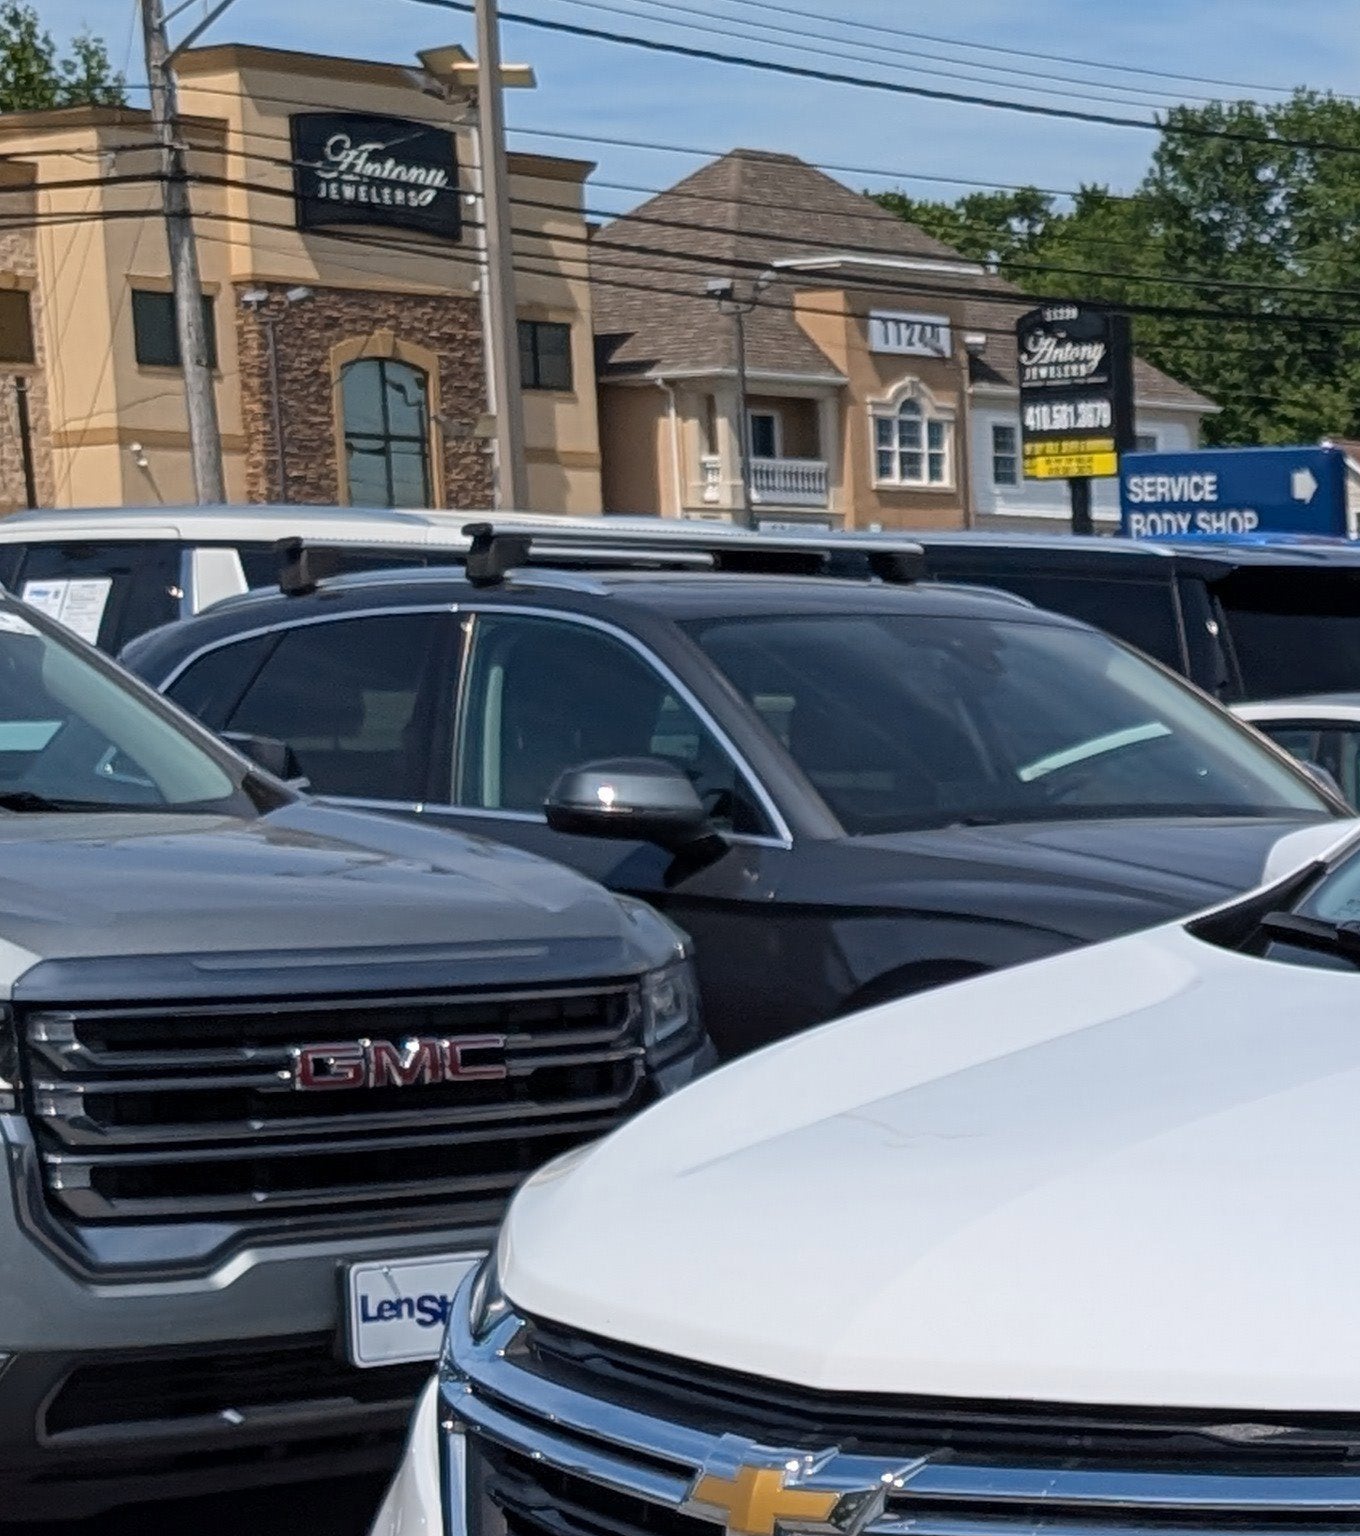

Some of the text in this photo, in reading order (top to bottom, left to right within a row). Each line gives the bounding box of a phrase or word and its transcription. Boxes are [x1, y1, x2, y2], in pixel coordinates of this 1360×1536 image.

[318, 181, 419, 207] JEWELERS
[1020, 328, 1107, 374] Antony
[1127, 473, 1219, 503] SERVICE
[1129, 510, 1260, 538] BODY SHOP
[296, 1034, 508, 1091] GMC
[360, 1294, 451, 1327] LenSt
